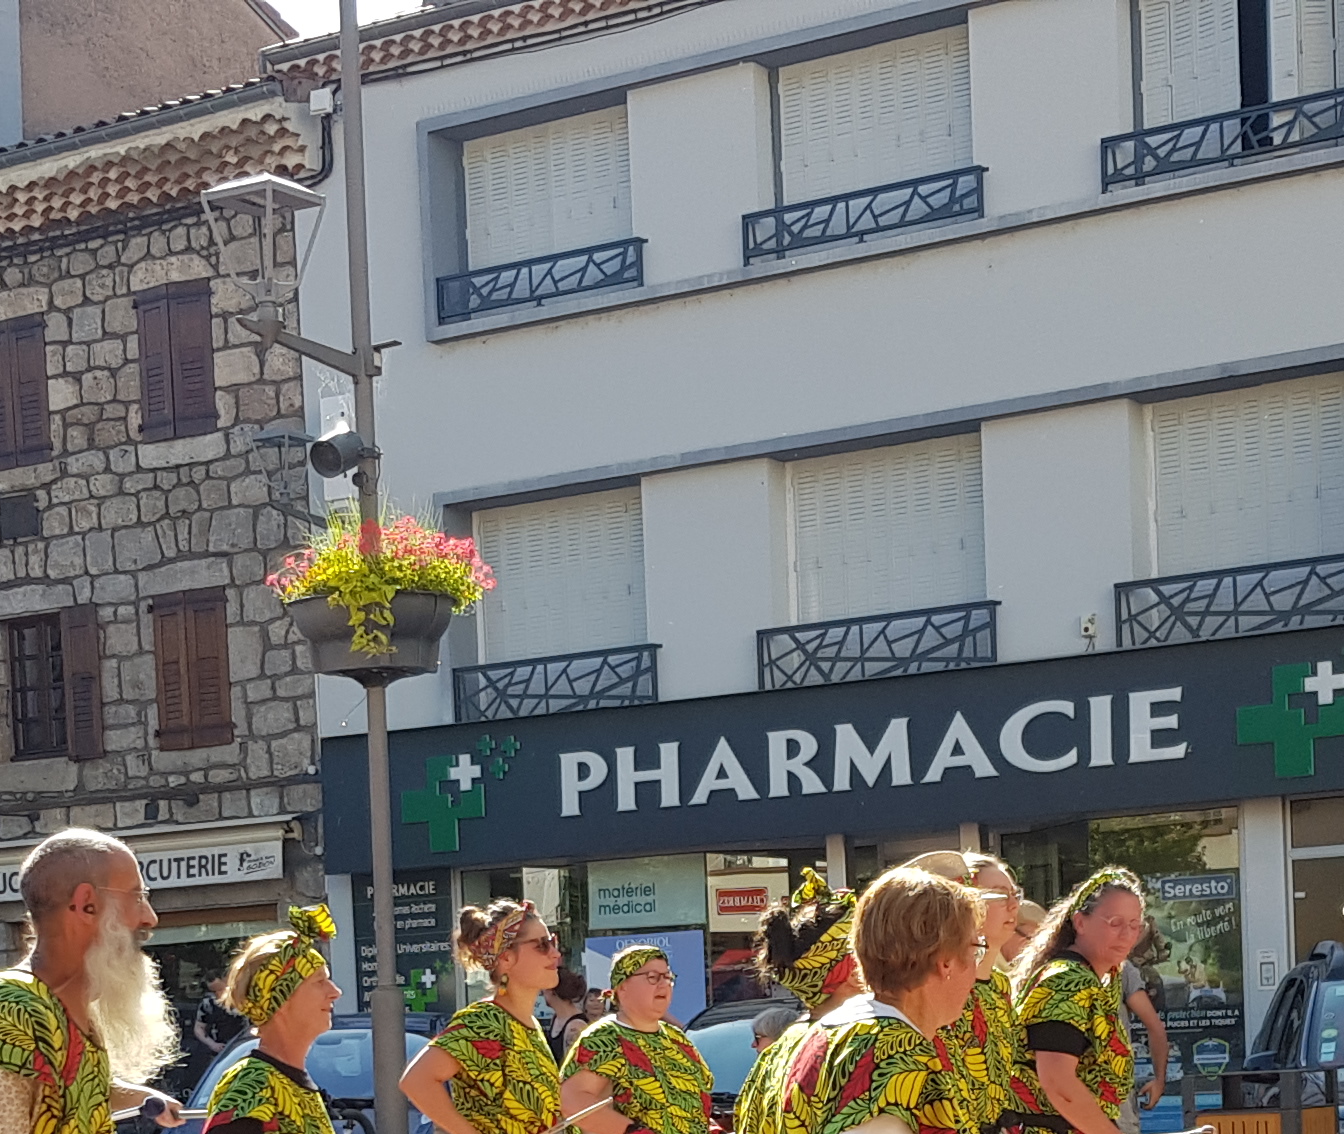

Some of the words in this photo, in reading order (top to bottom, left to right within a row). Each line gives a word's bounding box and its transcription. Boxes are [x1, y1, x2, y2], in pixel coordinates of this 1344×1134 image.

[559, 686, 1192, 818] PHARMACIE
[367, 881, 436, 899] PRMACIE
[598, 881, 656, 899] matériel
[1164, 879, 1229, 898] Seresto
[598, 900, 656, 916] médical
